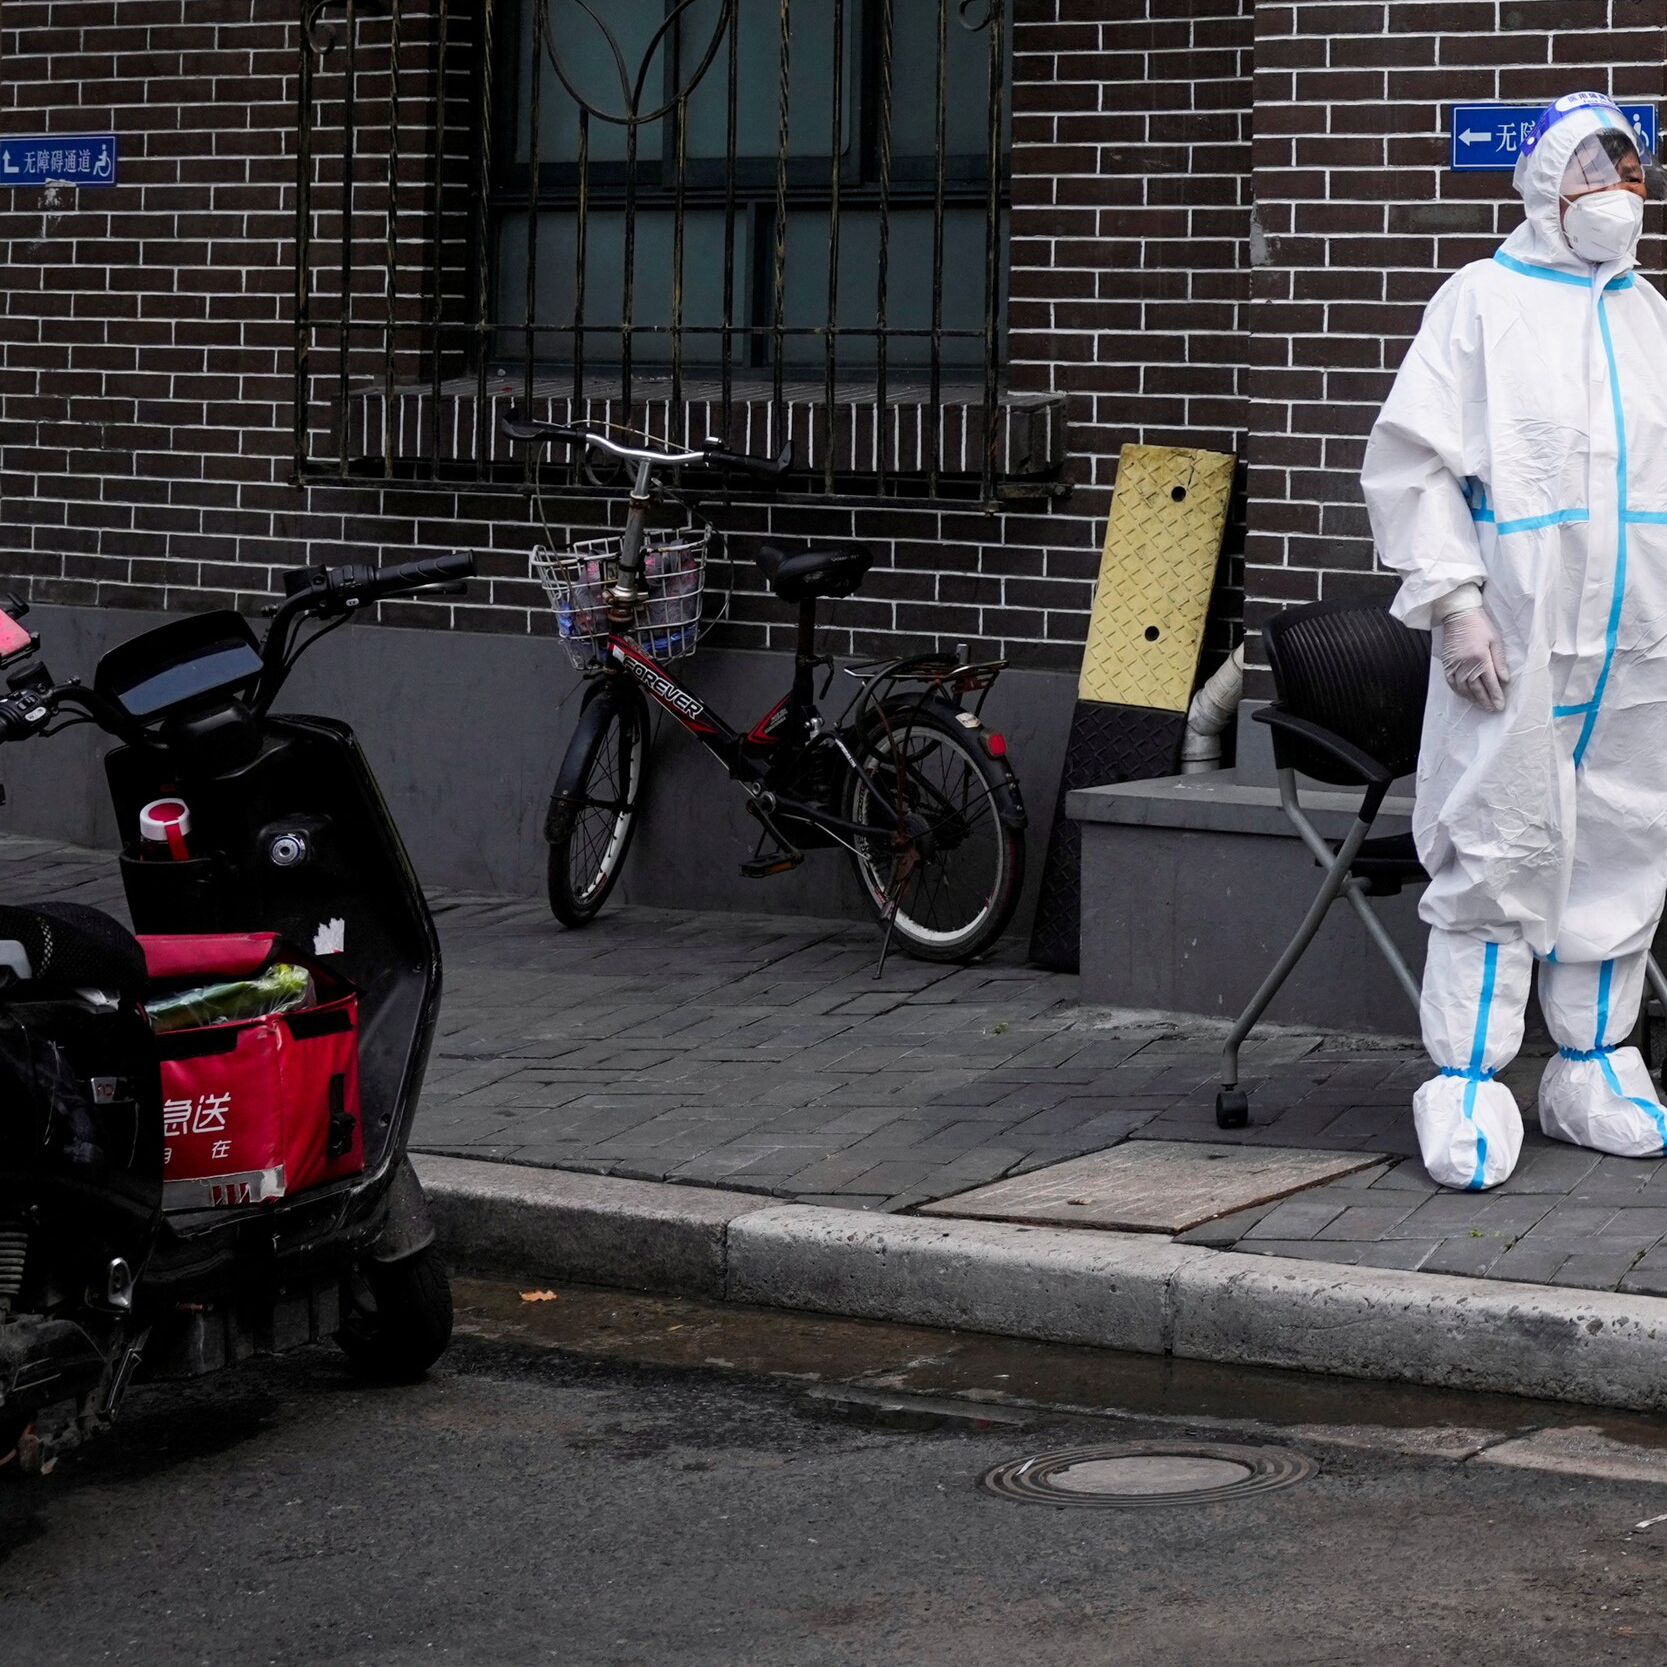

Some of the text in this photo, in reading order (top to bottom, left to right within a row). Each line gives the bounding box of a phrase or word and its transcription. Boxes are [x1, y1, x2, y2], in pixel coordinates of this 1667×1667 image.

[23, 149, 91, 174] 无障碍通道
[623, 656, 703, 721] FOREVER
